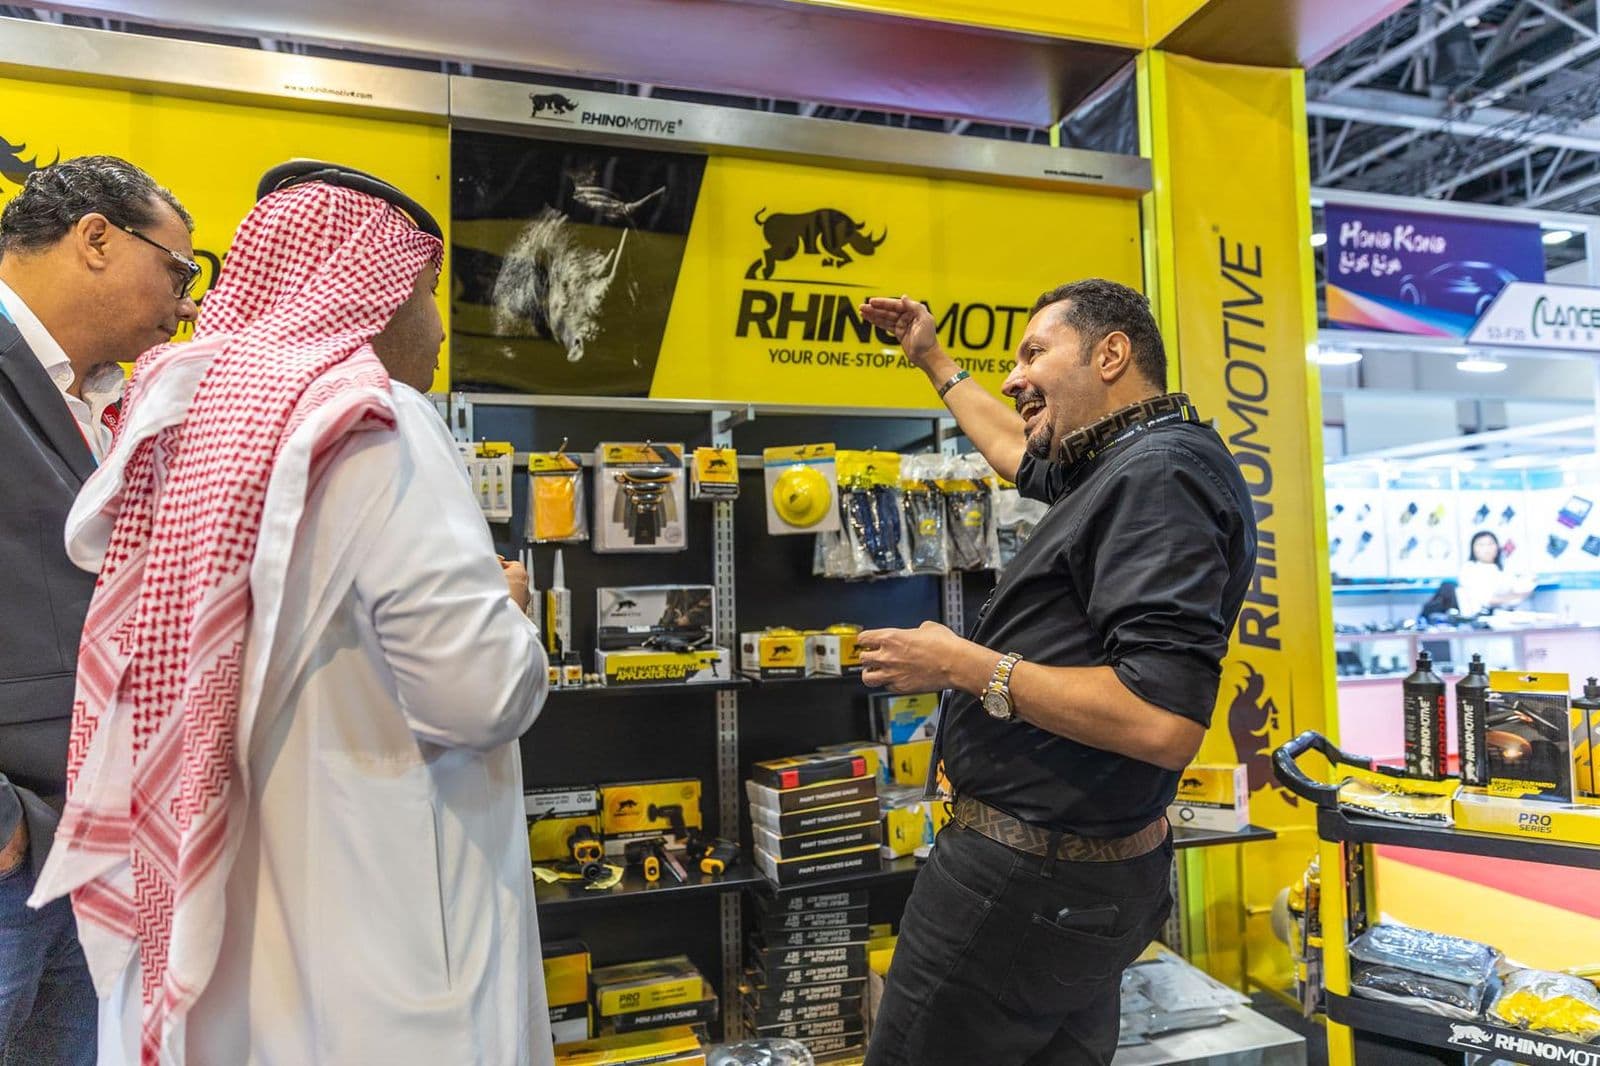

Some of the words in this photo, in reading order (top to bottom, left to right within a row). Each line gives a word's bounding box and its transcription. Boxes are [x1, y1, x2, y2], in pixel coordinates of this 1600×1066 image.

[768, 349, 812, 365] YOUR
[816, 351, 895, 369] ONE-STOP
[897, 355, 995, 373] AUOTIVE
[1518, 813, 1552, 826] PRO
[1519, 824, 1552, 833] SERIES
